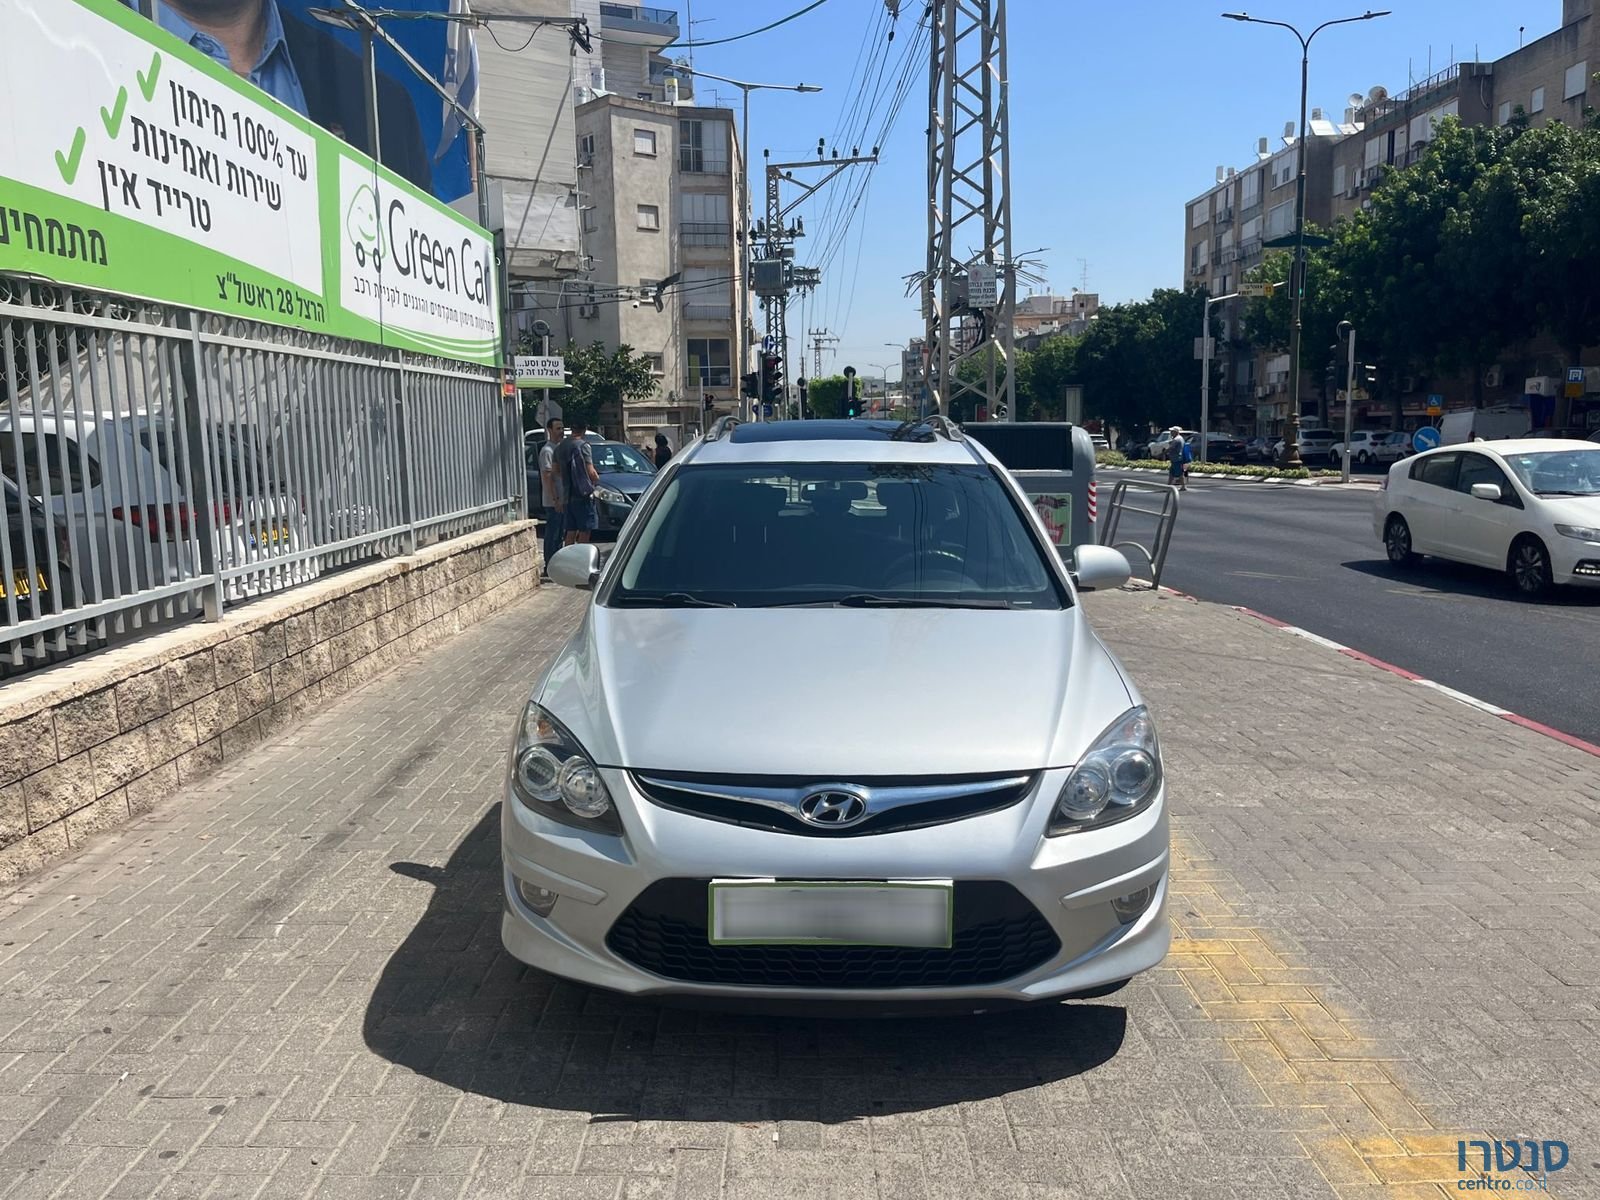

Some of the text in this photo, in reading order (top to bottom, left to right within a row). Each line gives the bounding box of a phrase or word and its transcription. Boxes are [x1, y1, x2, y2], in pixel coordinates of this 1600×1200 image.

[169, 80, 308, 181] עד 100% מימון
[130, 116, 281, 211] שירות ואמינות
[97, 160, 211, 232] טרייד אין
[388, 199, 490, 306] Green Car
[277, 287, 294, 315] 28
[353, 276, 371, 297] רכב
[295, 291, 325, 323] הרצל
[538, 368, 559, 376] אצלנו
[541, 358, 559, 367] שלם
